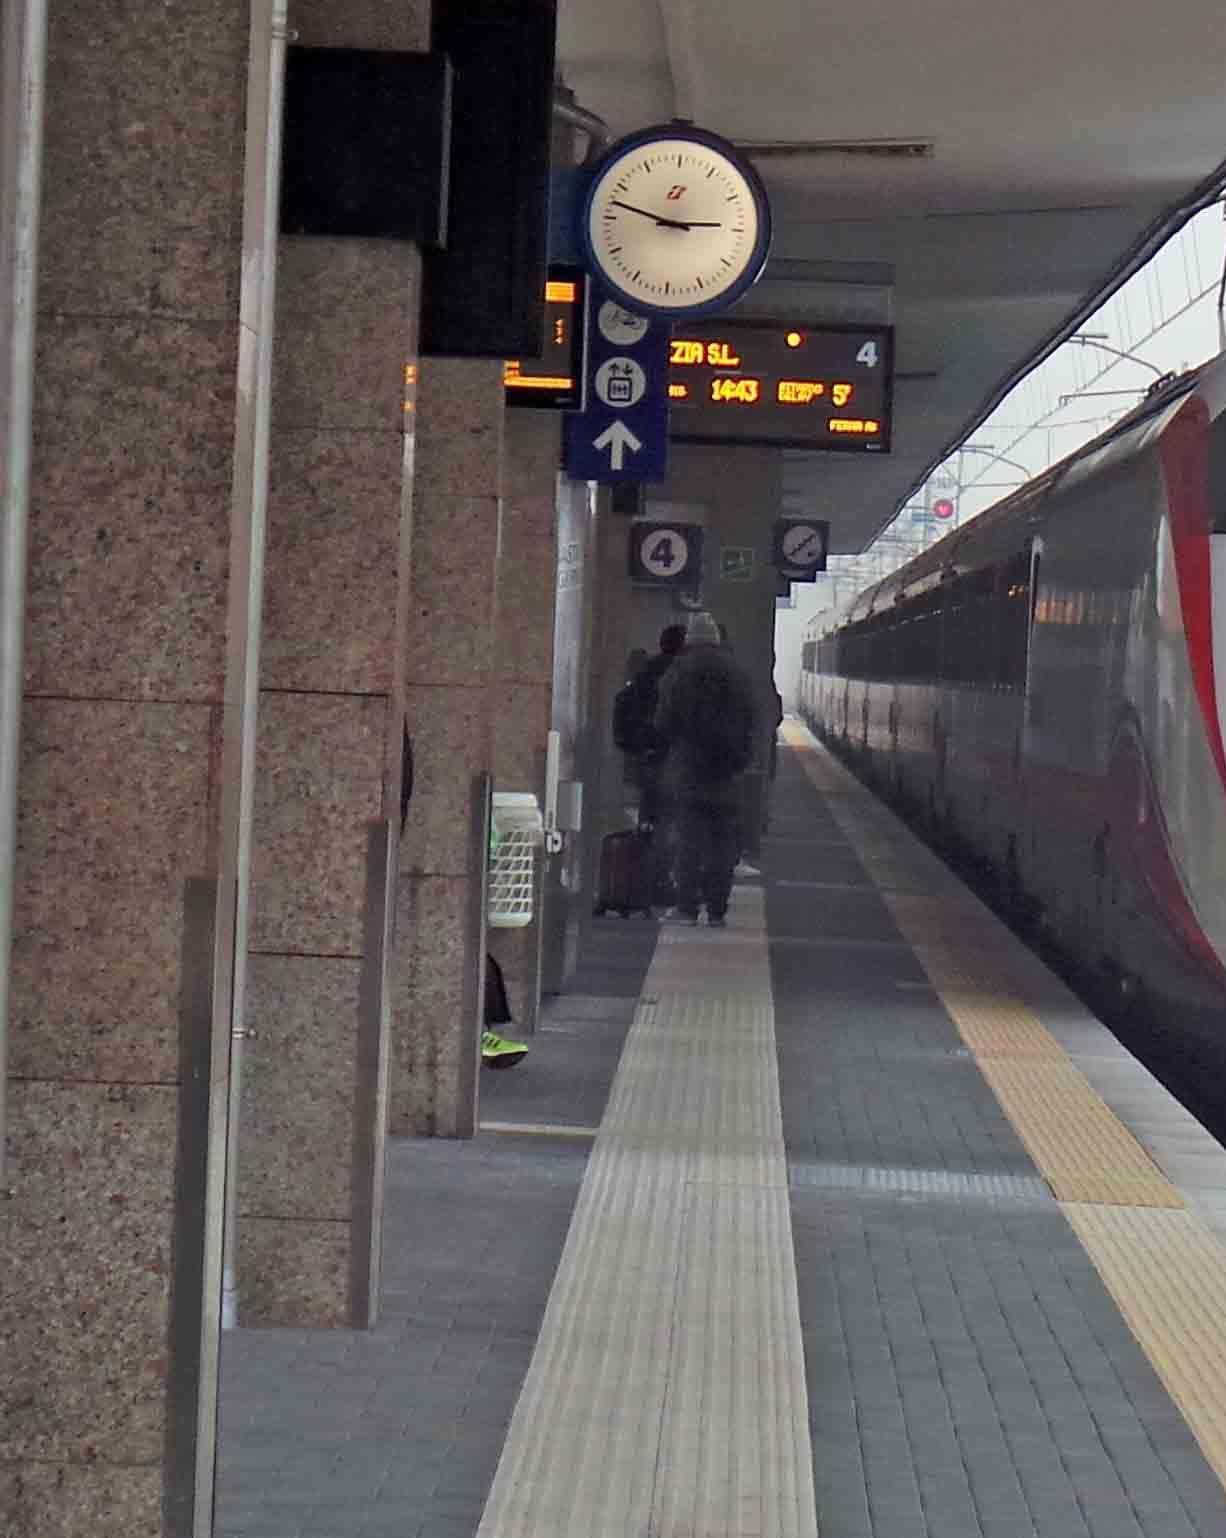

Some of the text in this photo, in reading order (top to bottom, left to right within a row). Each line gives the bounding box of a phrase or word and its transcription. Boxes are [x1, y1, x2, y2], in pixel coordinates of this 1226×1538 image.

[856, 341, 878, 367] 4
[711, 379, 758, 402] 14:43
[650, 537, 675, 568] 4
